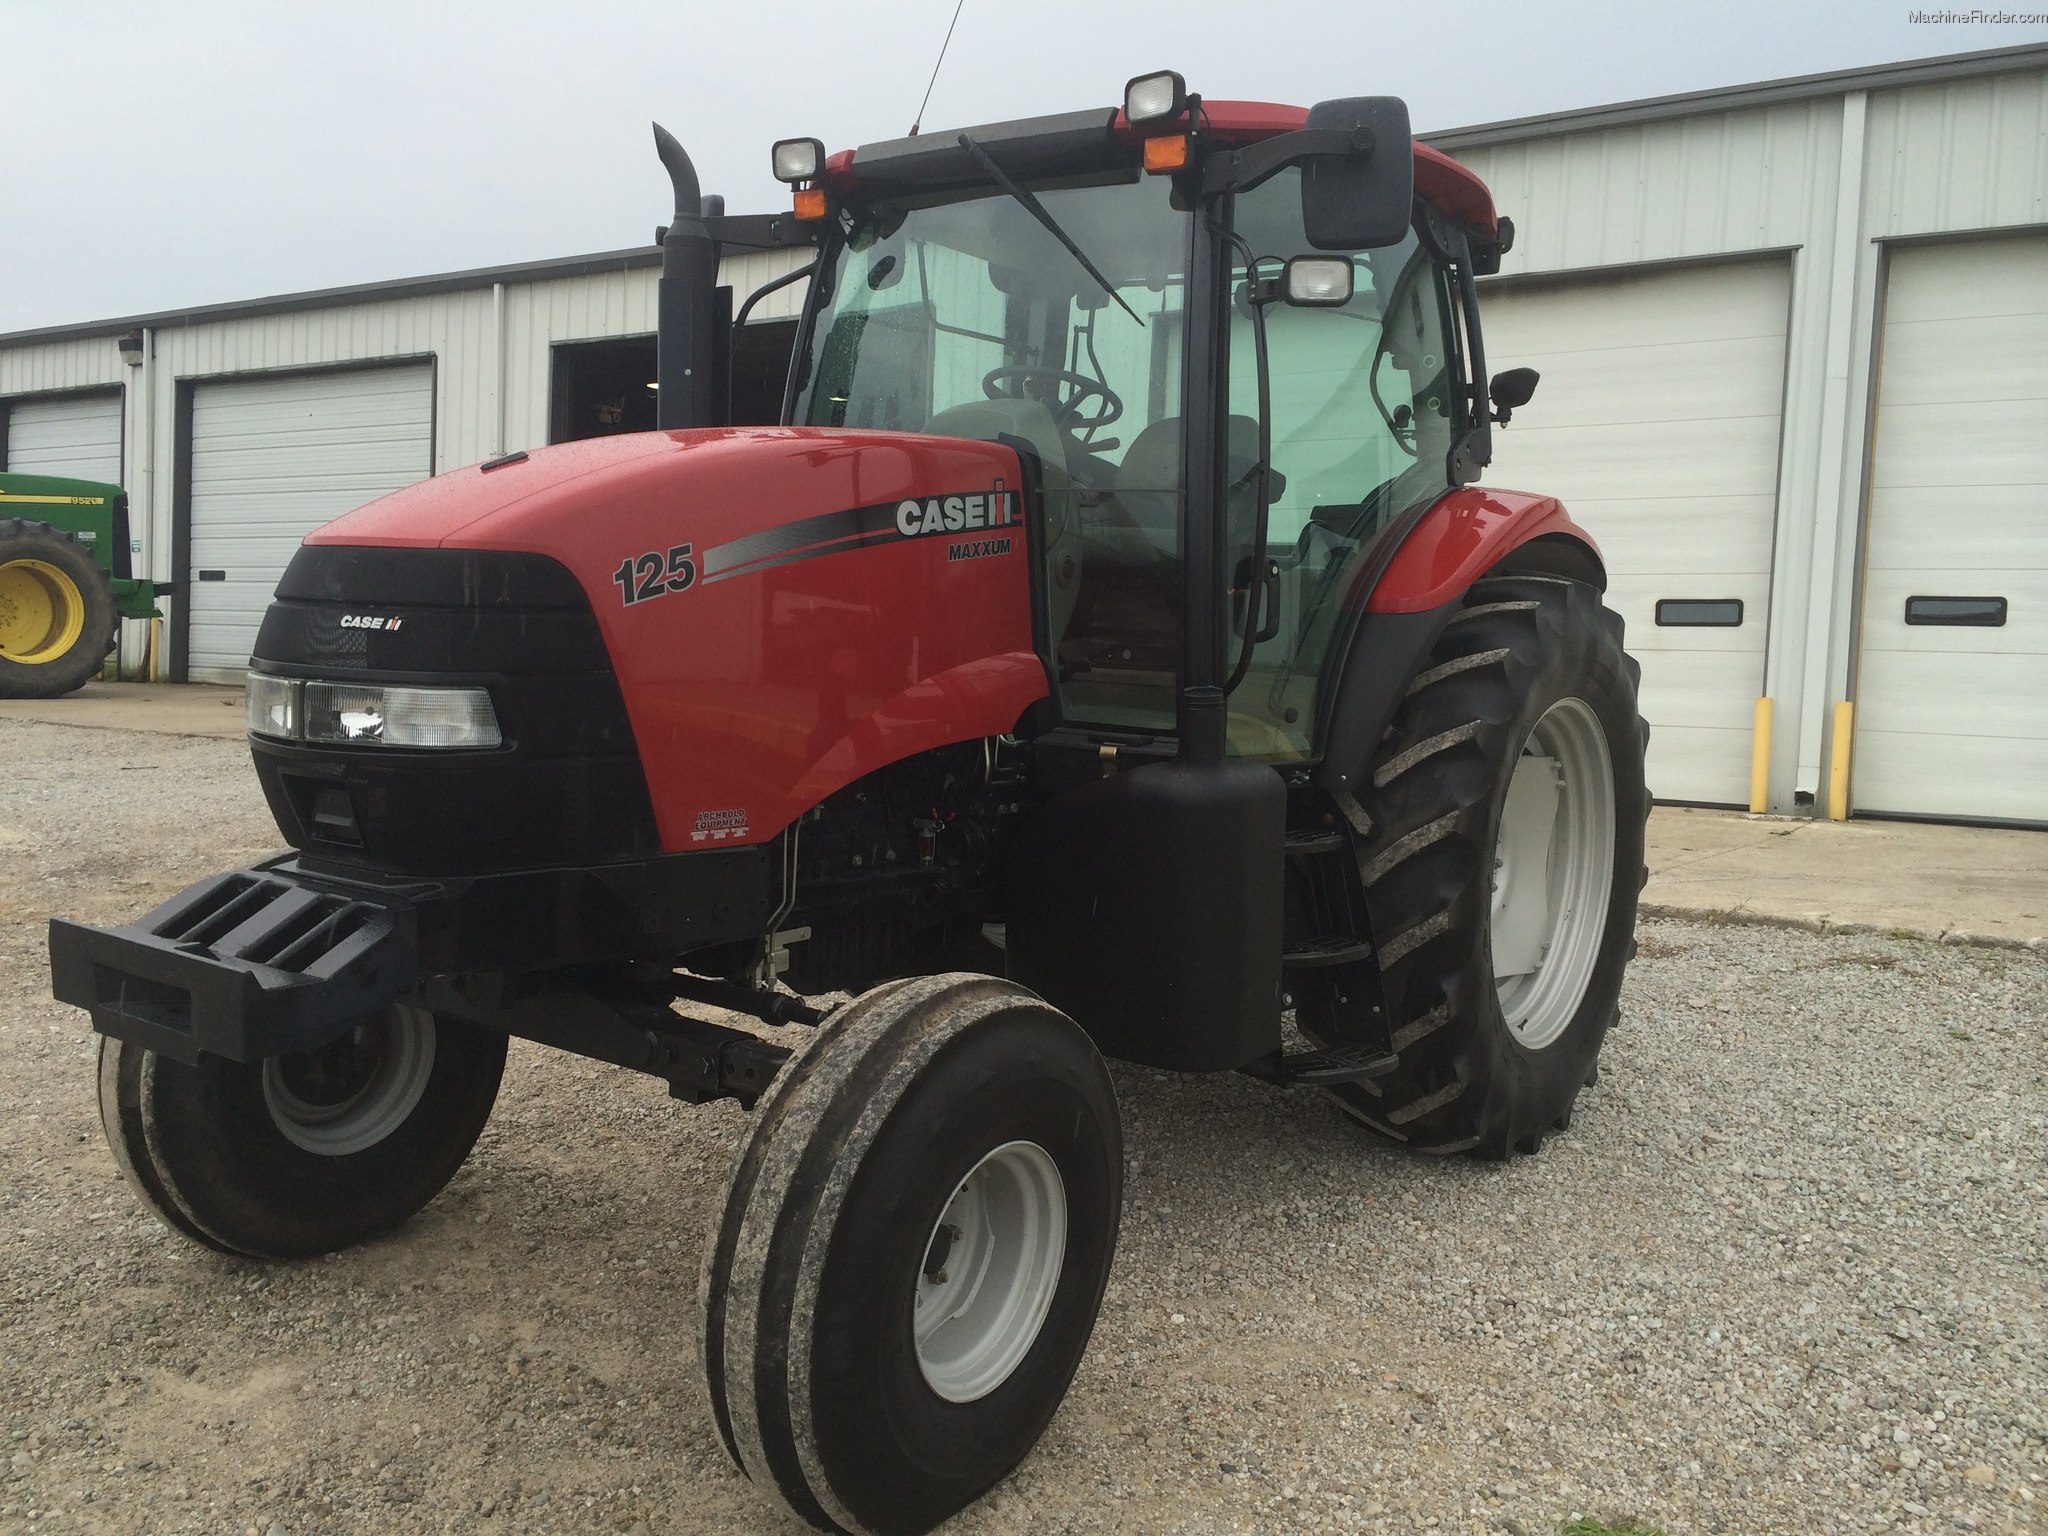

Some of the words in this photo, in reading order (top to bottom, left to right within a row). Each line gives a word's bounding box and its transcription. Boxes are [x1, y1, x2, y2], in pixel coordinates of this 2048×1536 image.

[896, 497, 984, 536] CASE
[948, 538, 1011, 562] MAXXUM
[613, 543, 696, 607] 125
[340, 615, 384, 630] CASE
[694, 817, 746, 830] EQUIPMENT
[698, 809, 745, 821] ARCHBOLD
